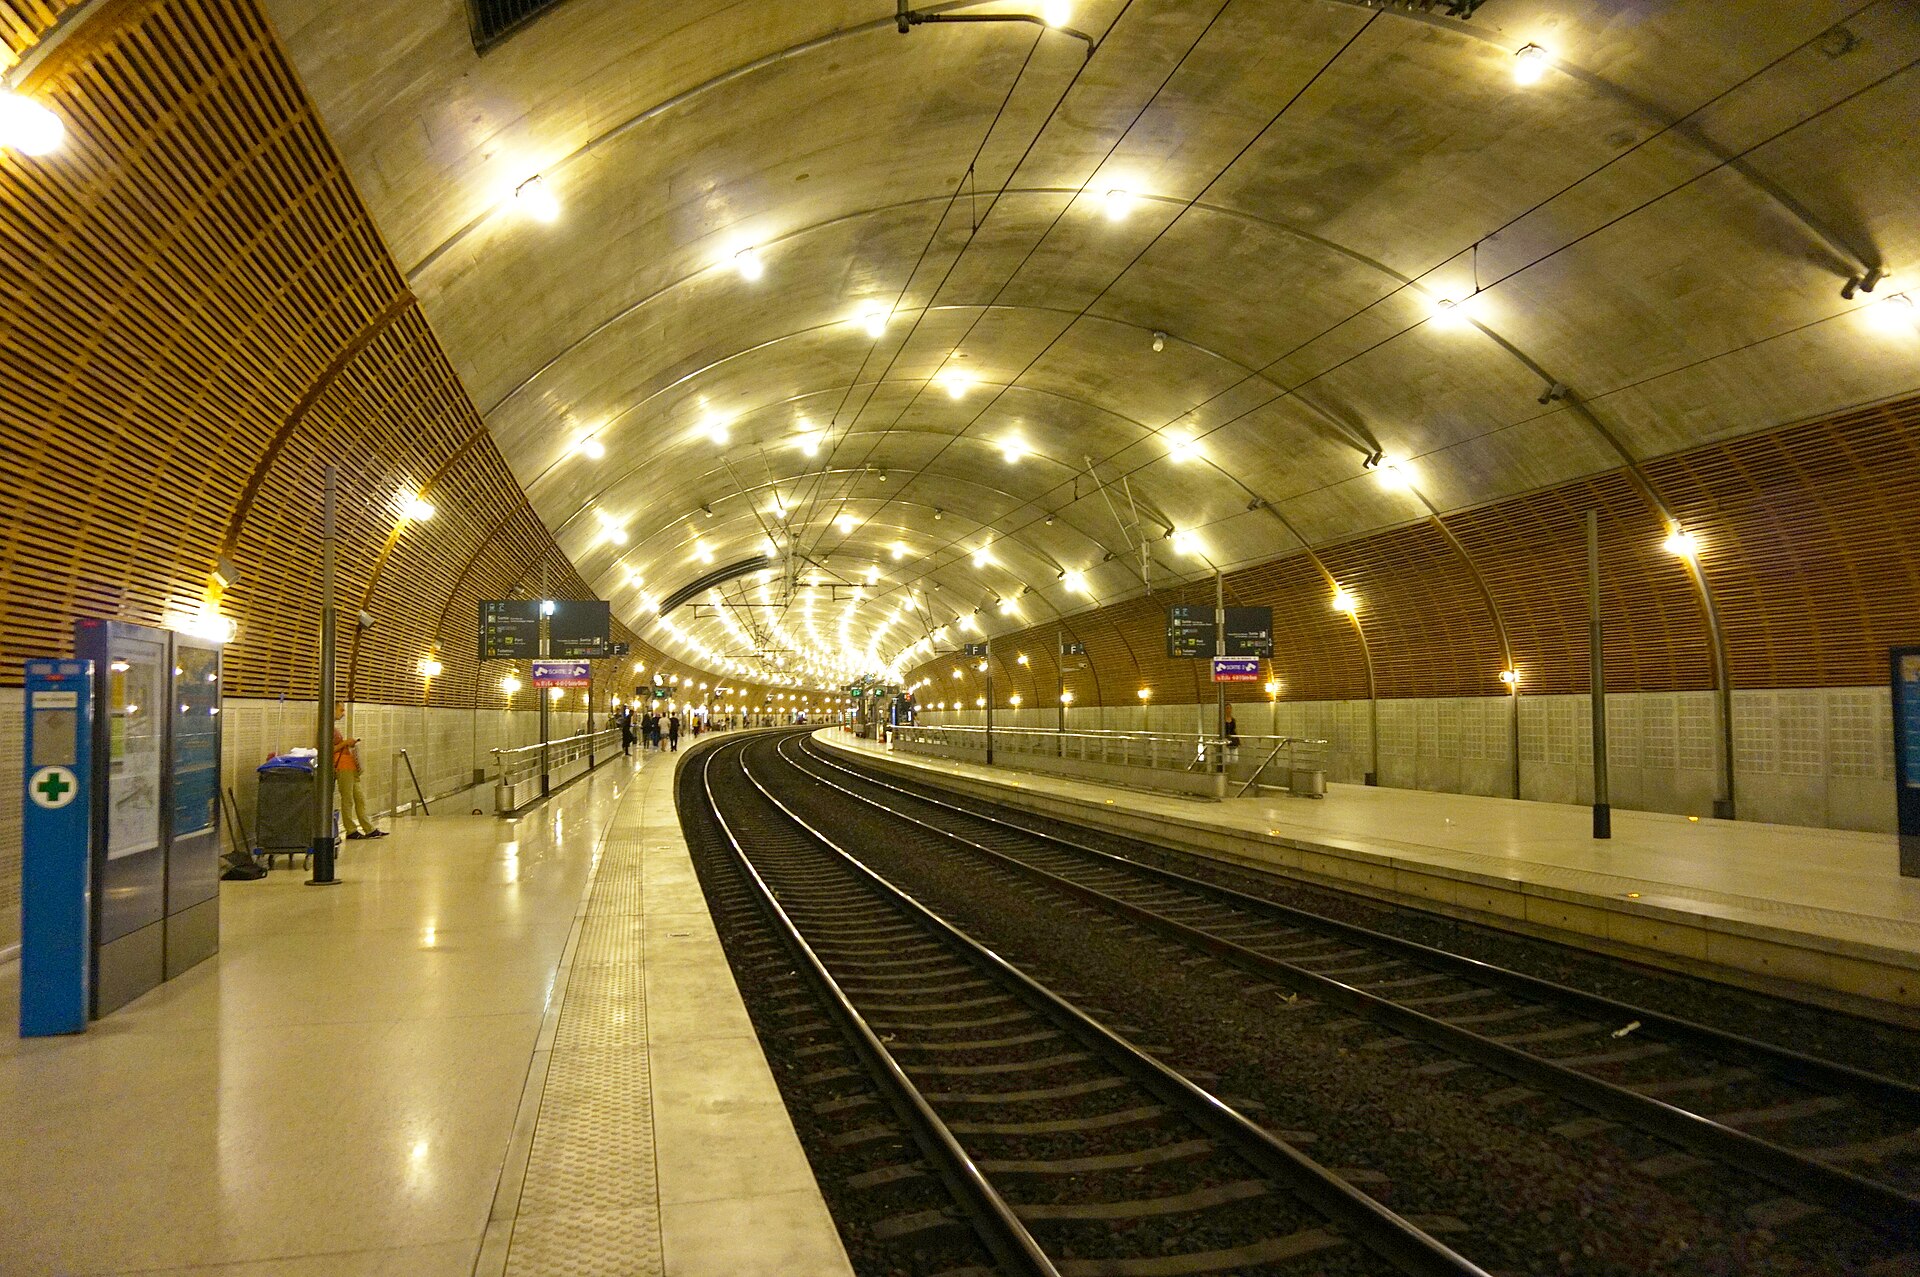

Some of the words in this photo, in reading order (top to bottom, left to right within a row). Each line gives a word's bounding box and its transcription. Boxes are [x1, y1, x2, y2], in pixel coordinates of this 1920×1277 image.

[614, 645, 620, 654] F
[973, 647, 978, 655] F
[1071, 646, 1076, 654] F
